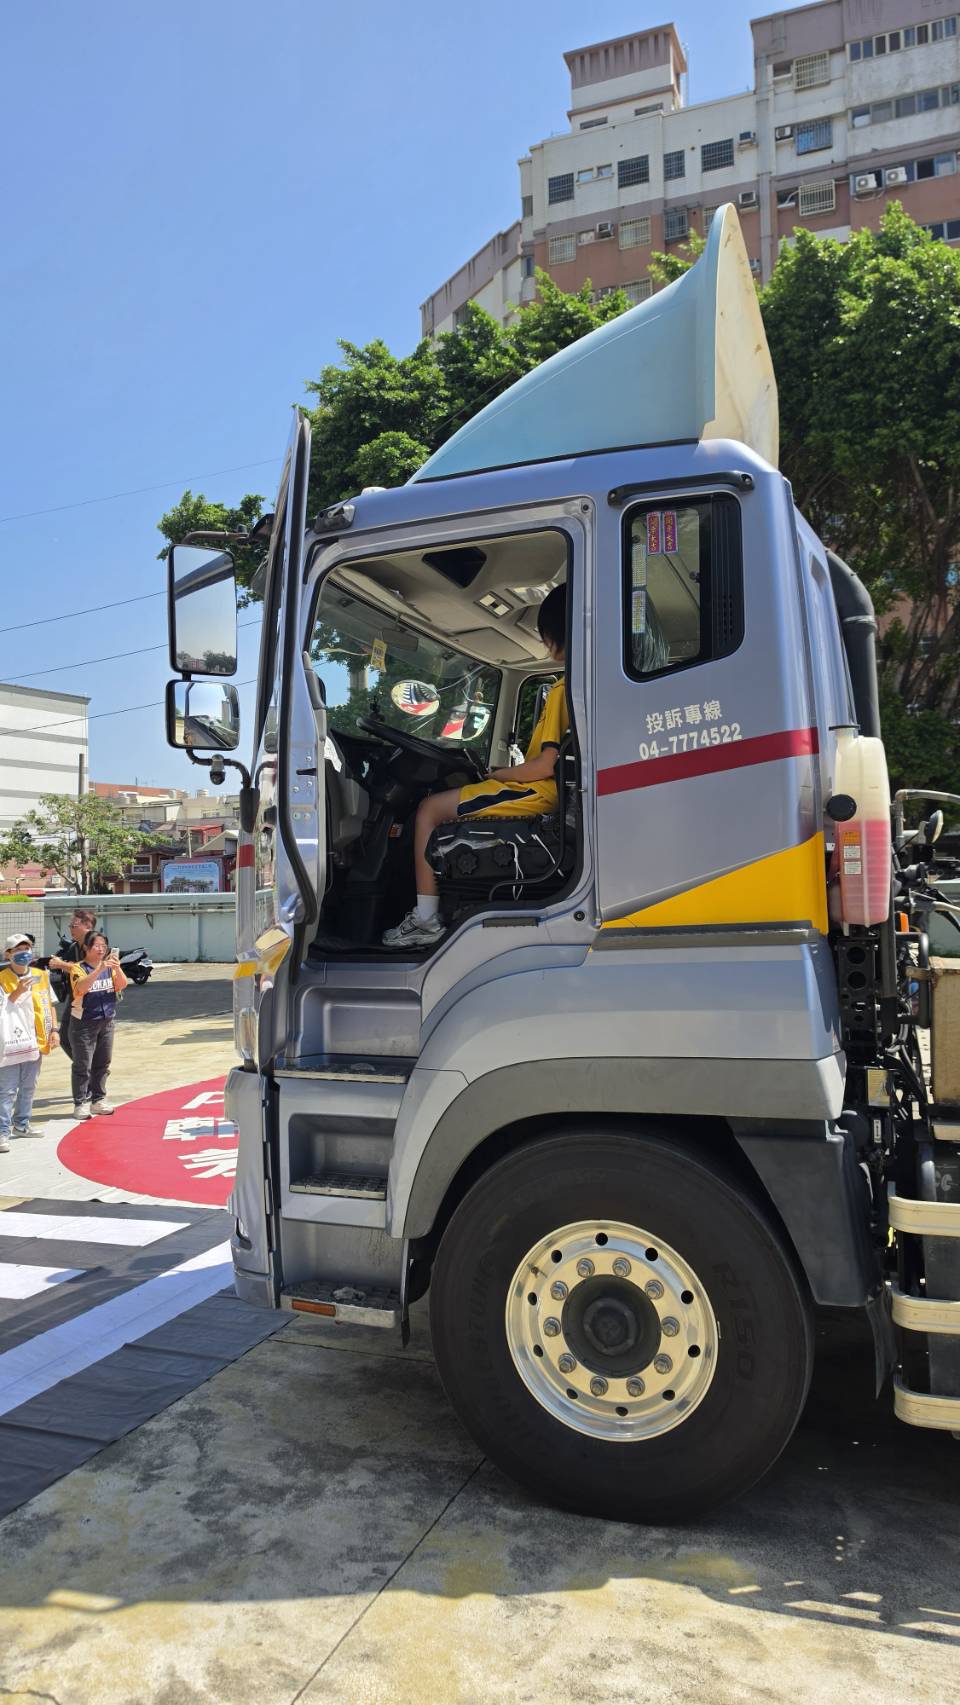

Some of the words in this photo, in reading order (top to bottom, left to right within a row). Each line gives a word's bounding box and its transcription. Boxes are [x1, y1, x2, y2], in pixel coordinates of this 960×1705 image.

[646, 699, 722, 735] 投訴專線
[639, 722, 742, 760] 04-7774522
